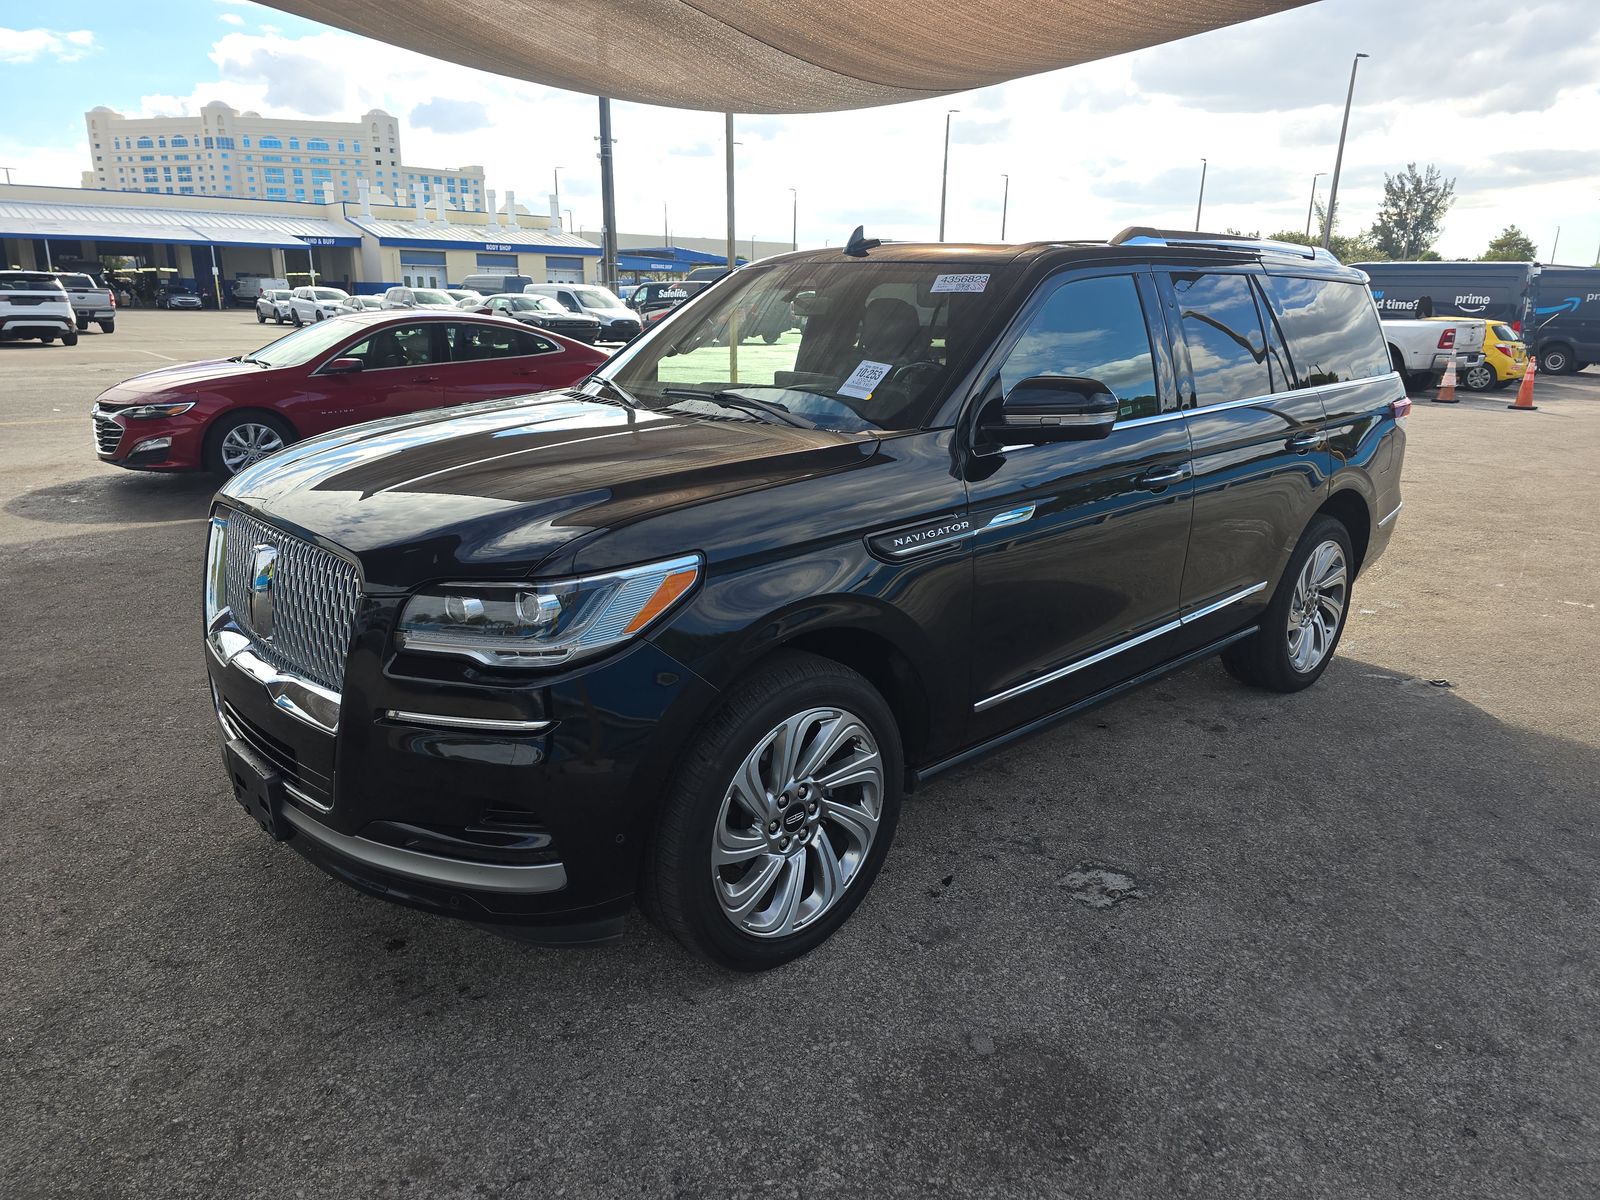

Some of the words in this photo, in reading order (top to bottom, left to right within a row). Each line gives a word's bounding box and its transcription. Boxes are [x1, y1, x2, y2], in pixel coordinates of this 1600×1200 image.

[941, 275, 988, 283] 4356823
[1455, 293, 1490, 306] prime
[1586, 293, 1600, 302] pr
[1386, 299, 1419, 310] time?
[893, 521, 969, 547] NAVIGATOR
